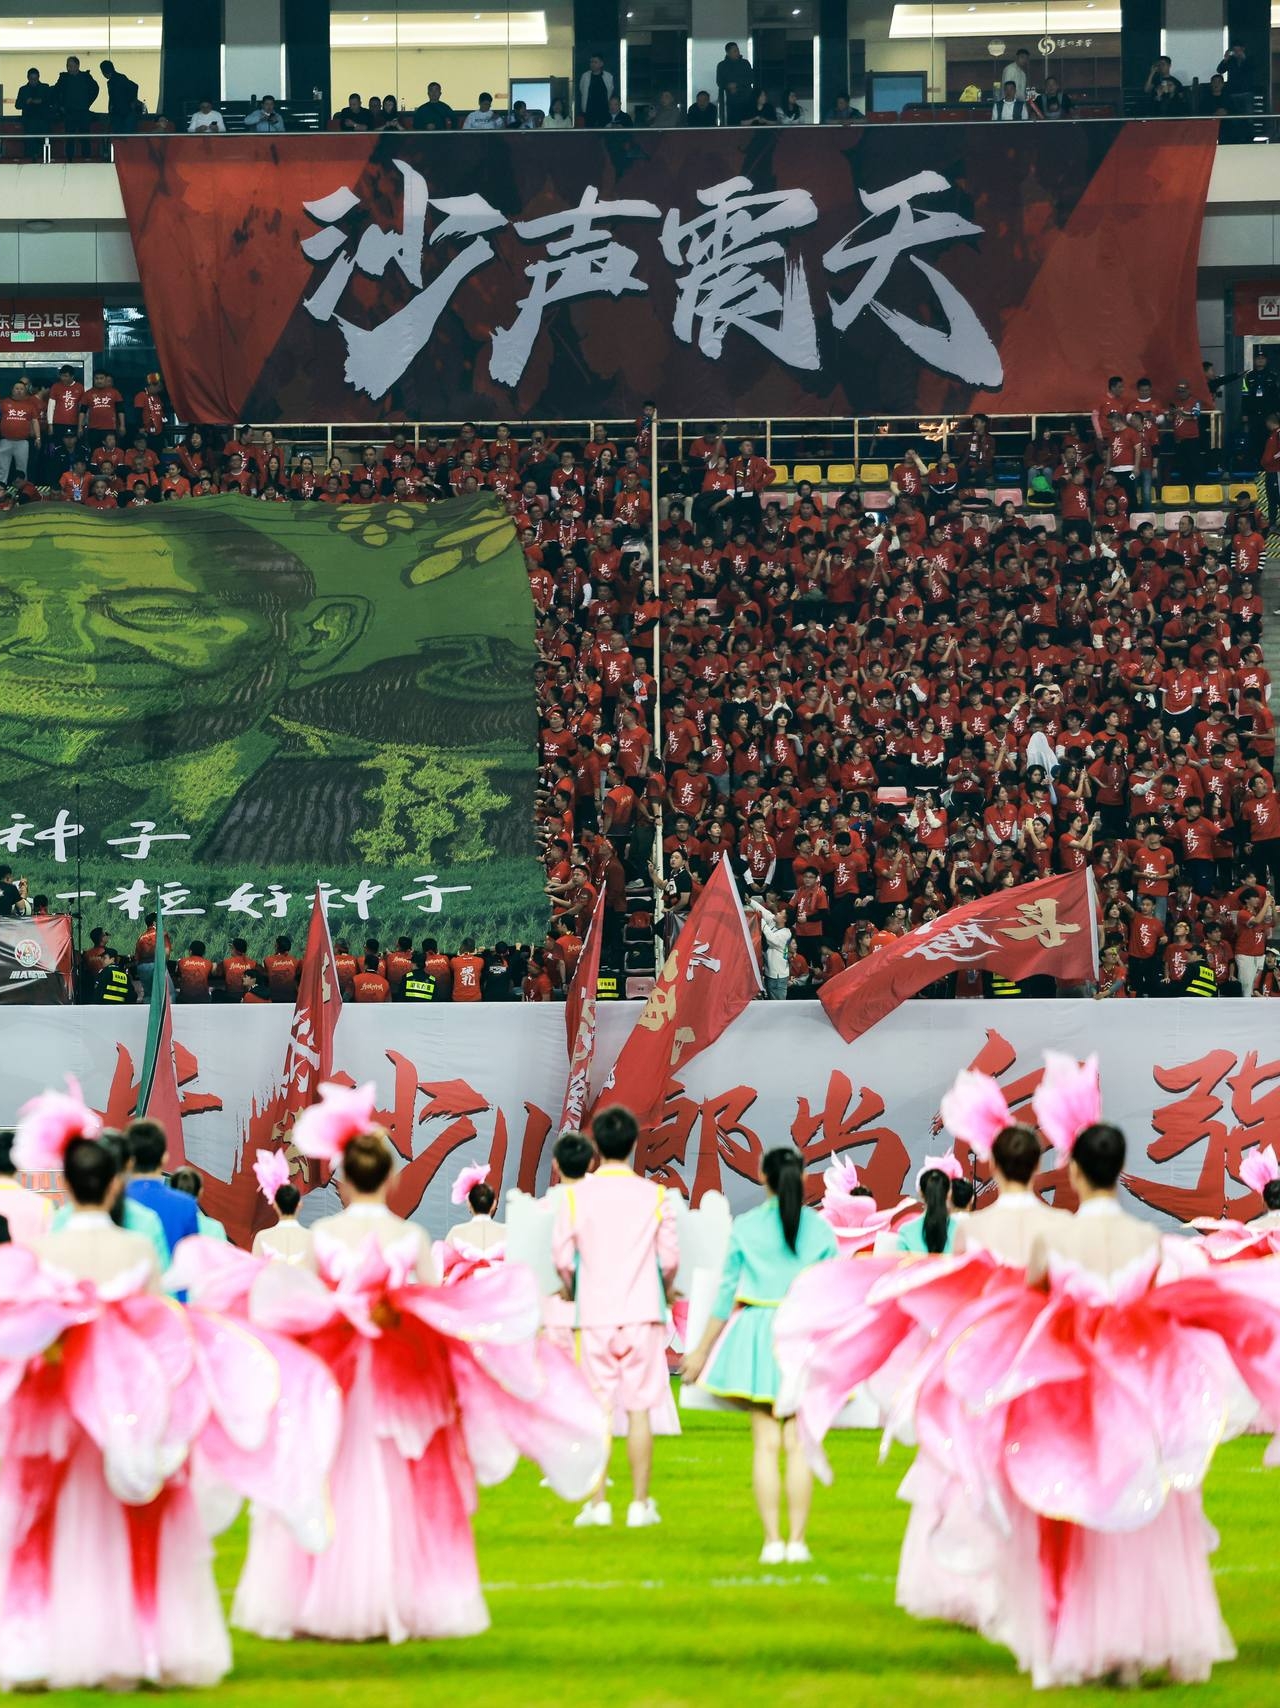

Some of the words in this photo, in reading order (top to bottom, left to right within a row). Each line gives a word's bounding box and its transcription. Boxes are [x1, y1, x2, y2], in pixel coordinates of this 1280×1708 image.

[301, 158, 1004, 400] 沙声震天
[63, 391, 74, 411] 长沙
[8, 409, 27, 418] 长沙
[608, 661, 620, 681] 长沙
[775, 740, 787, 761] 长沙
[681, 783, 696, 806] 长沙
[1254, 804, 1269, 825] 长沙
[1185, 829, 1198, 851] 长沙
[837, 863, 850, 885] 长沙
[1172, 952, 1187, 977] 长沙
